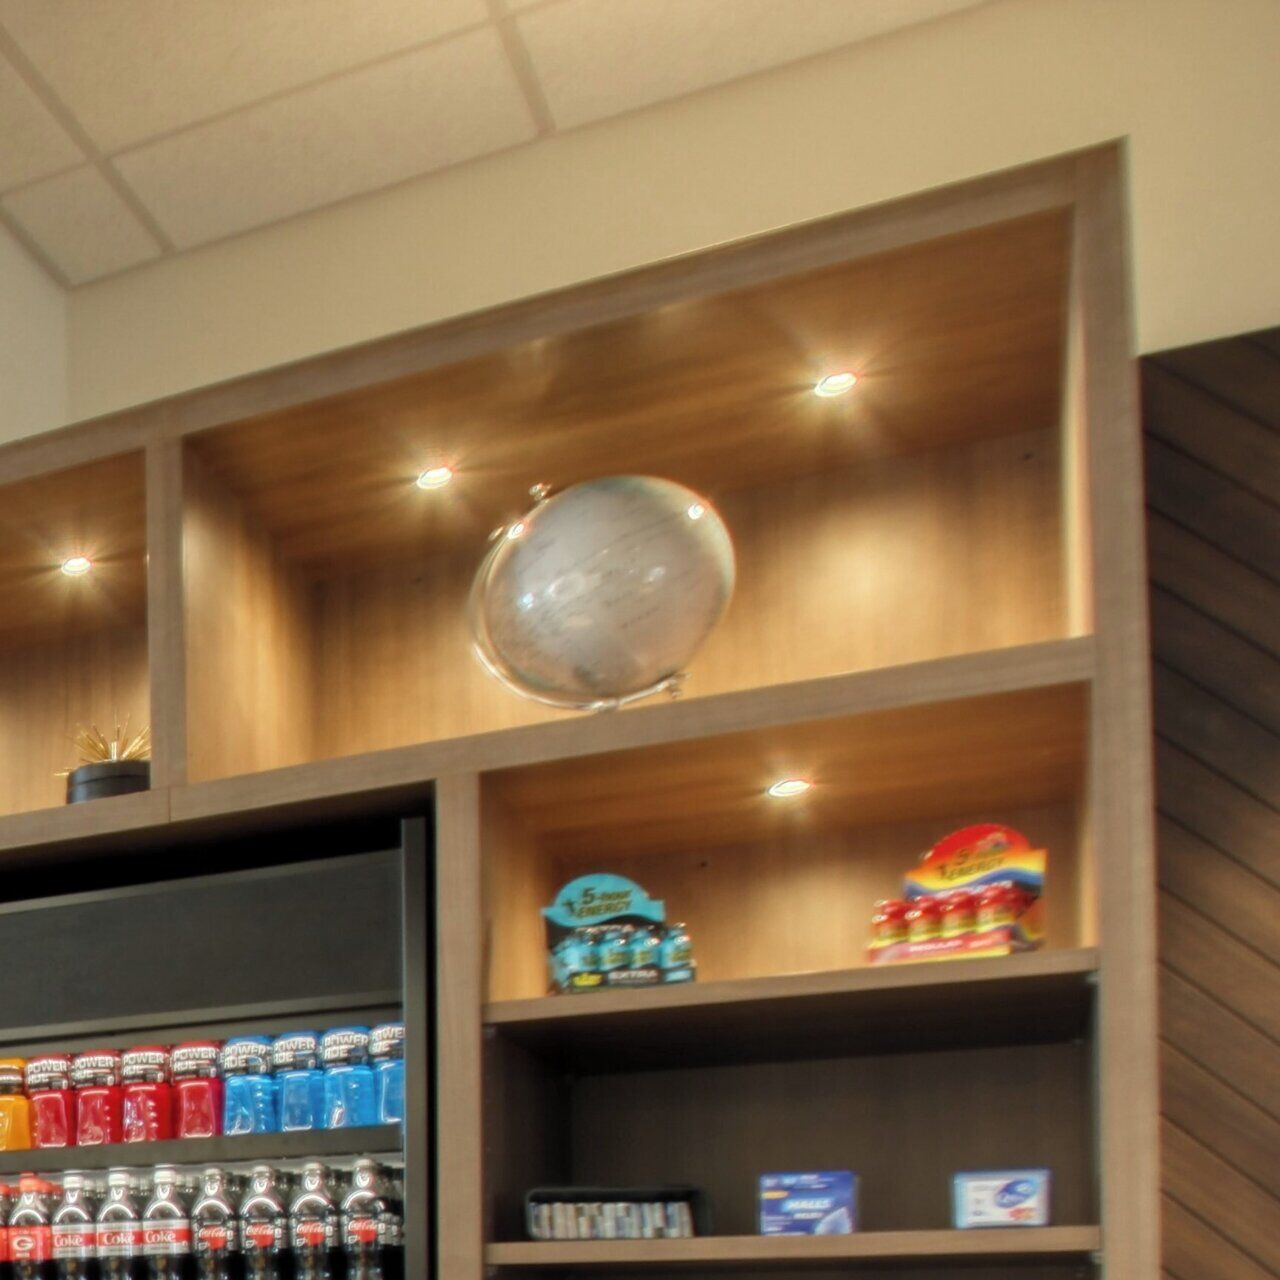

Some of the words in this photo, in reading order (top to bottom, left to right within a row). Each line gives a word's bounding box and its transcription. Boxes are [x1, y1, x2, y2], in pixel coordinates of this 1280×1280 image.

[54, 1234, 82, 1246] Coke
[103, 1232, 134, 1245] Coke
[145, 1230, 176, 1243] Coke
